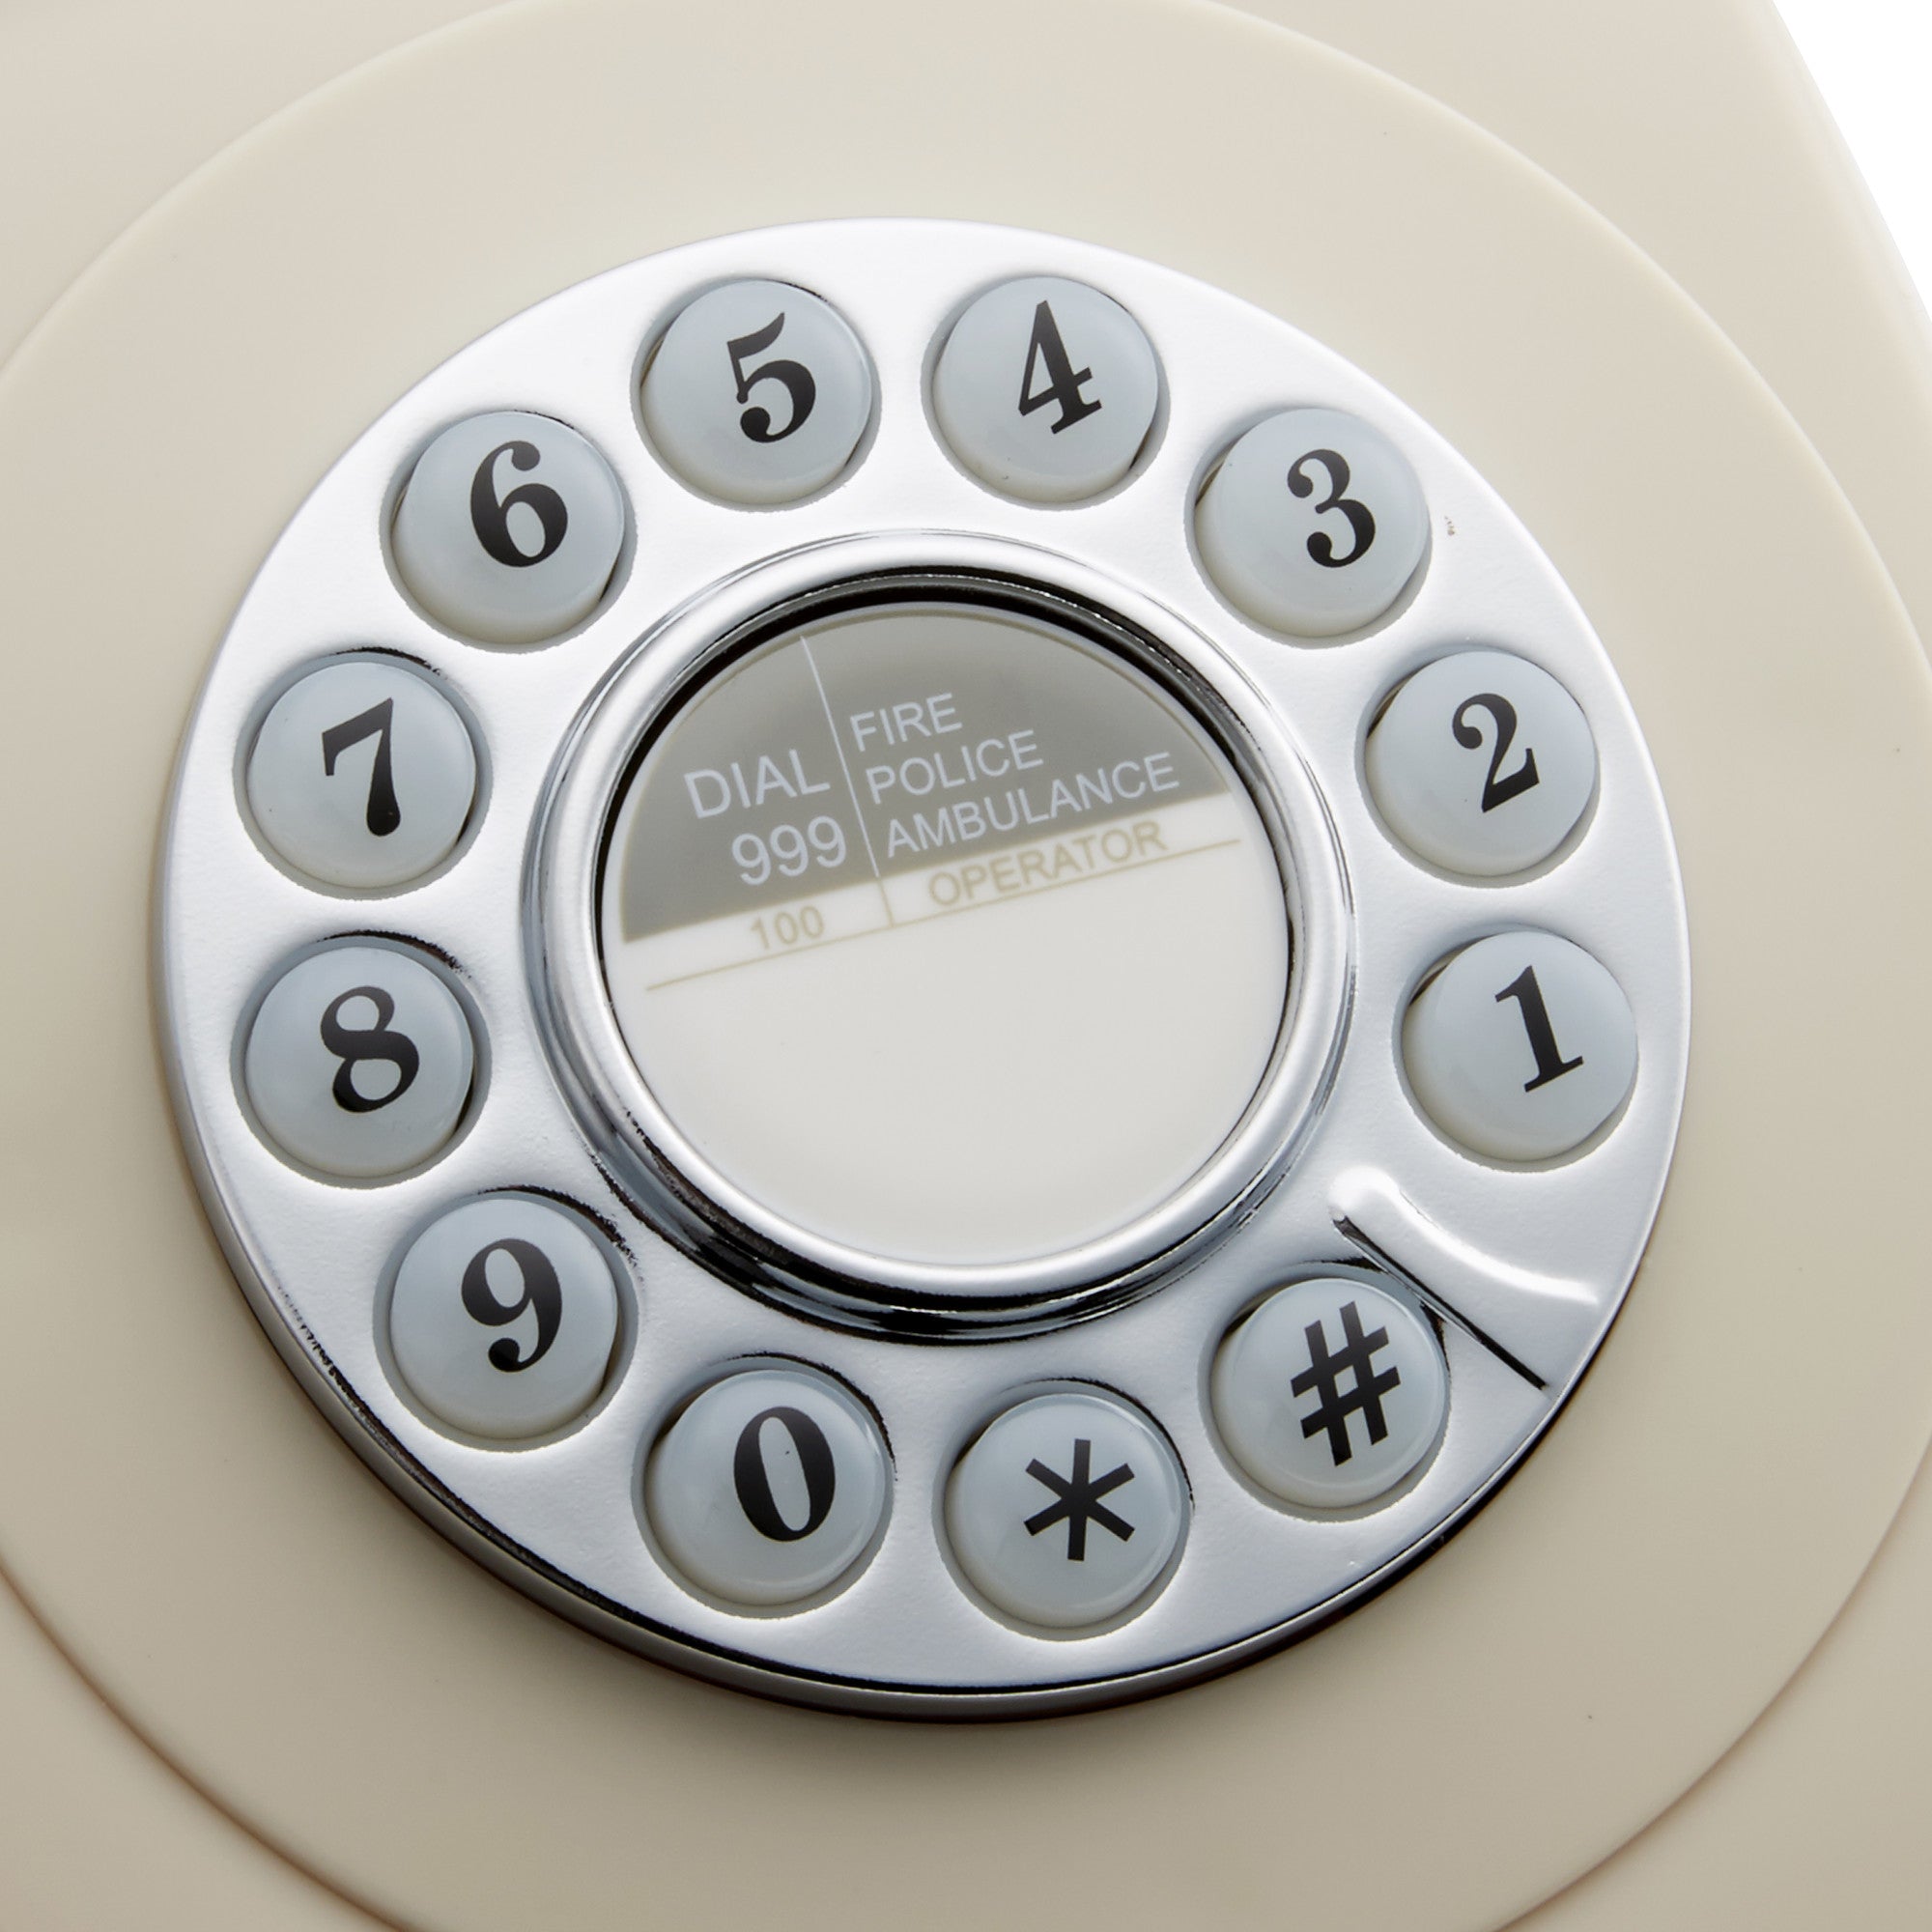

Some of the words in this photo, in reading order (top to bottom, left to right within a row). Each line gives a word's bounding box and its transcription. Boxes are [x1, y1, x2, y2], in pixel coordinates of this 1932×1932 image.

[727, 313, 815, 443] 5
[1019, 301, 1101, 434] 4
[470, 441, 567, 567] 6
[1288, 450, 1375, 568] 3
[323, 698, 401, 837] 7
[850, 693, 963, 753] FIRE
[866, 730, 1044, 804] POLICE
[1453, 694, 1539, 812] 2
[683, 749, 831, 818] DIAL
[887, 752, 1180, 858] AMBULANCE
[731, 815, 847, 886] 999
[928, 819, 1169, 908] OPERATOR
[751, 905, 825, 950] 100
[321, 987, 419, 1113] 8
[1495, 966, 1583, 1093] 1
[462, 1239, 562, 1373] 9
[733, 1407, 836, 1543] 0
